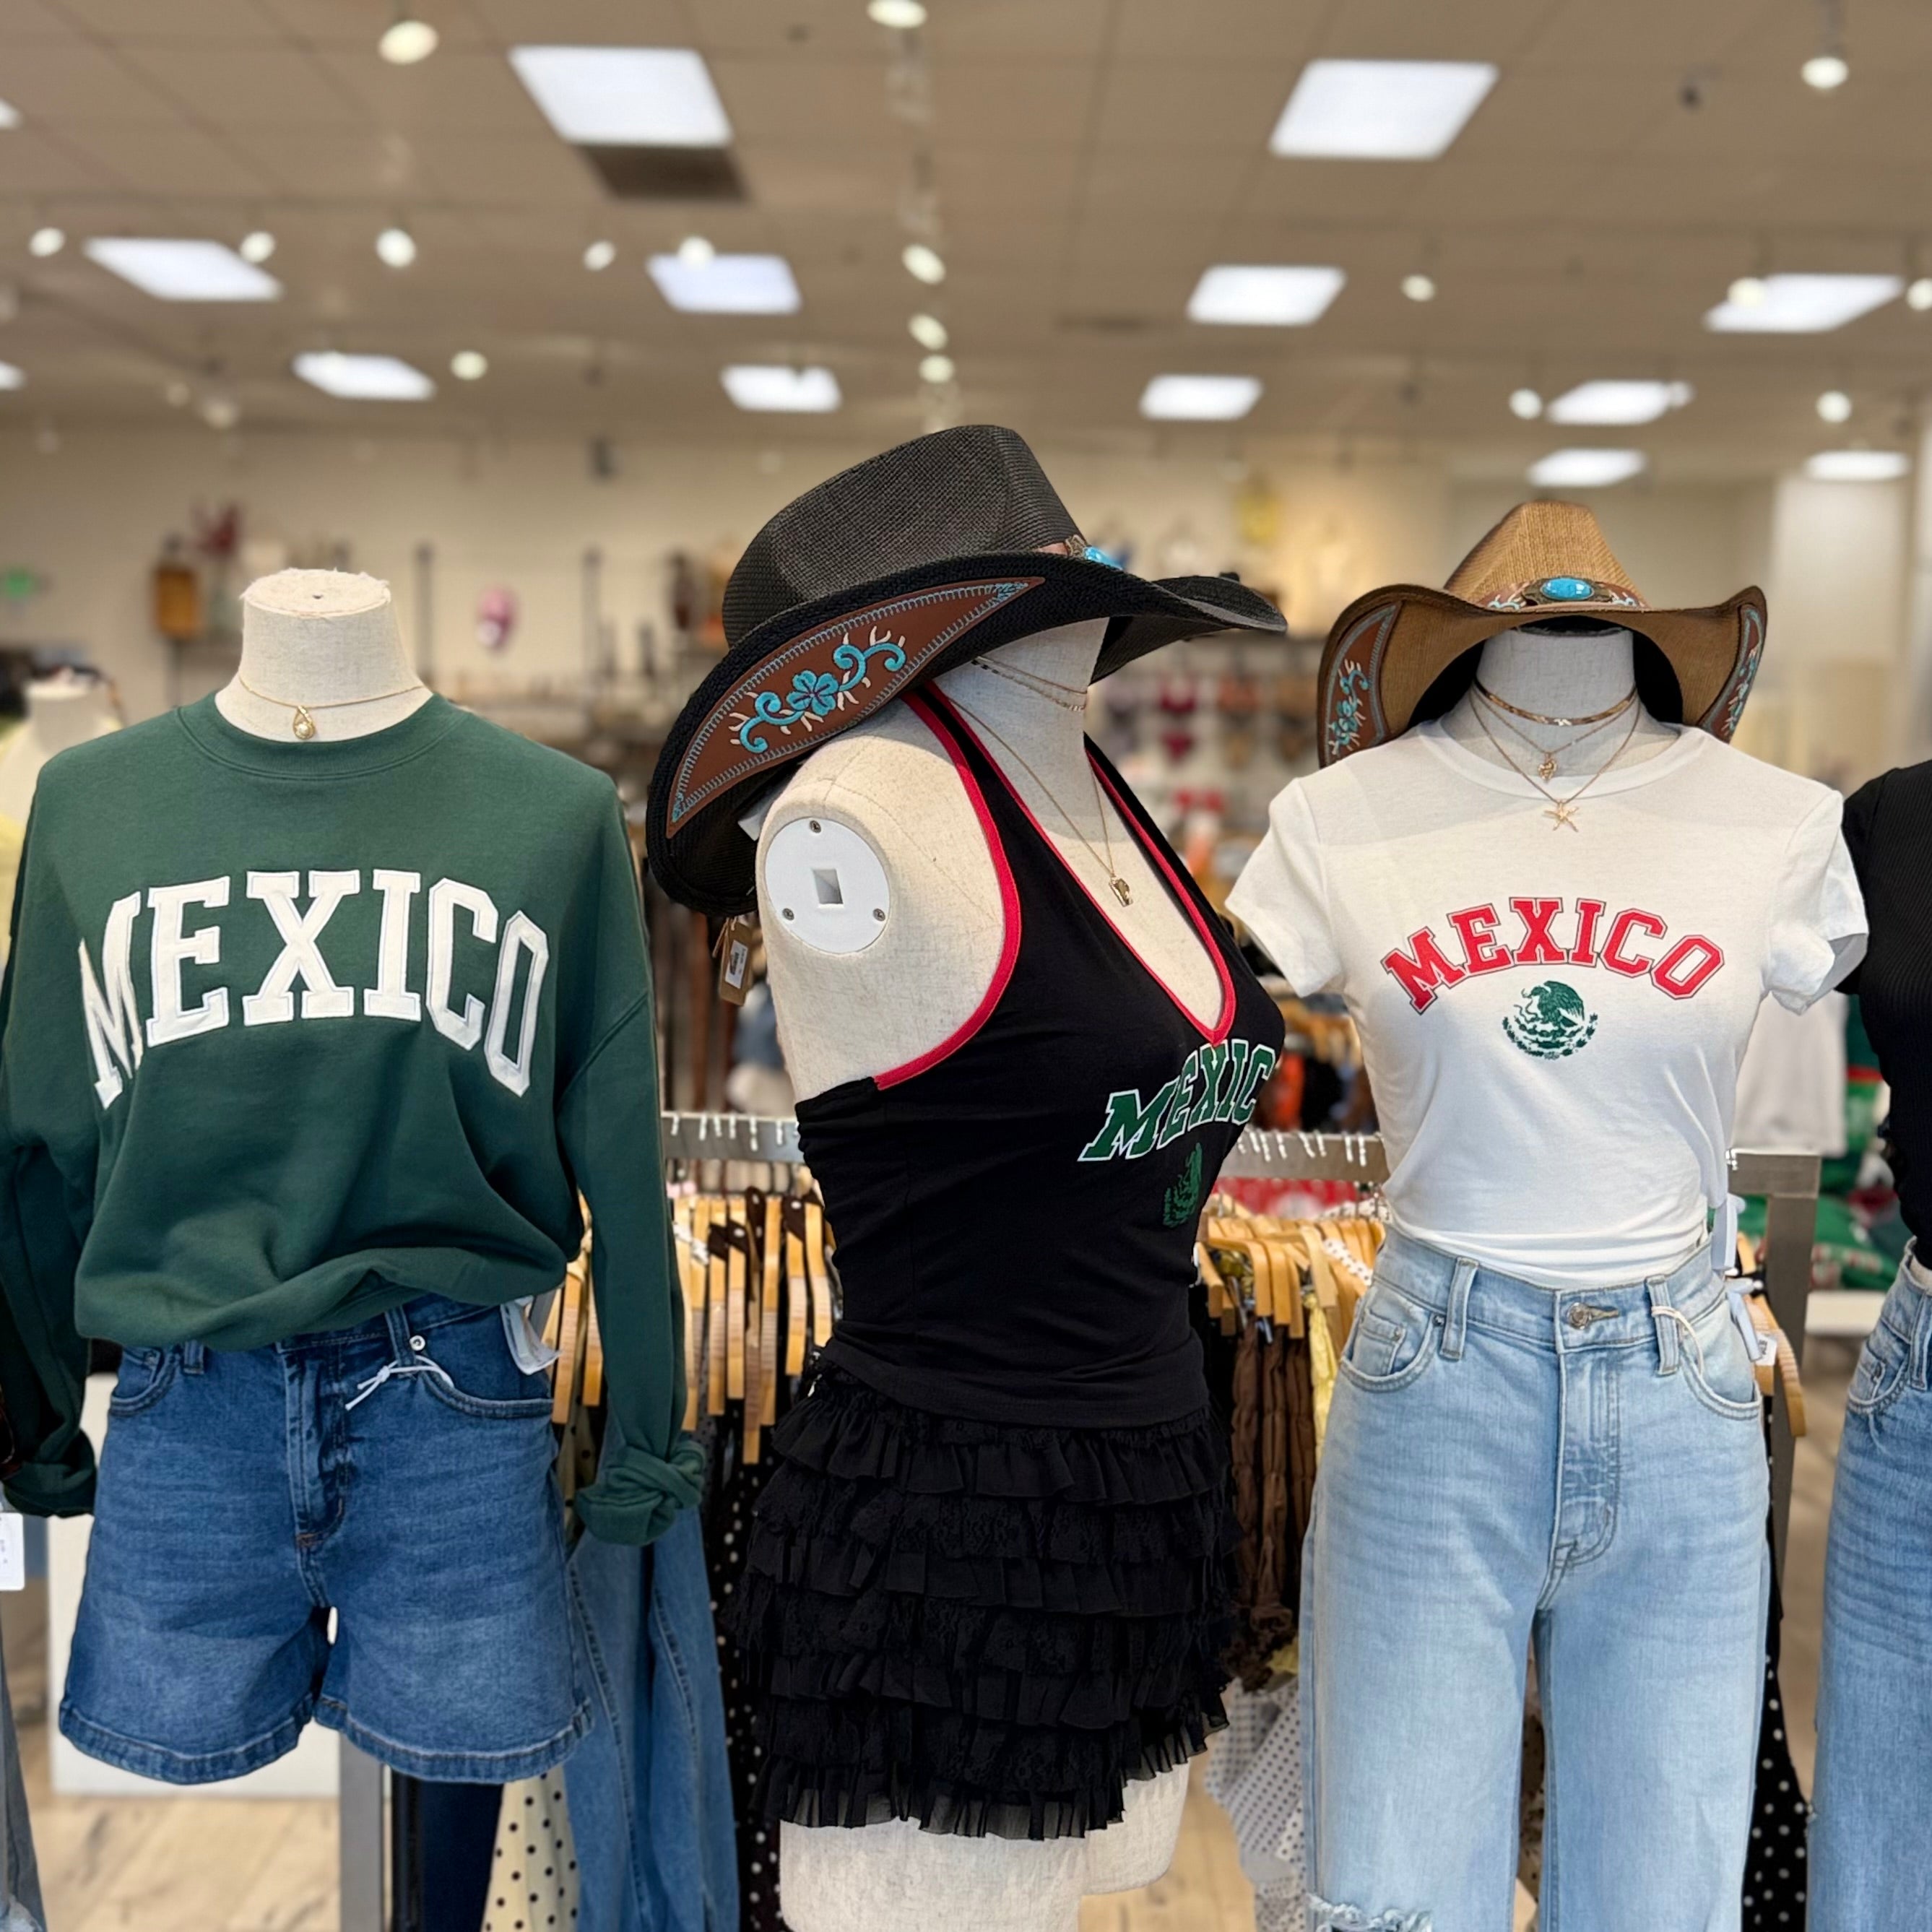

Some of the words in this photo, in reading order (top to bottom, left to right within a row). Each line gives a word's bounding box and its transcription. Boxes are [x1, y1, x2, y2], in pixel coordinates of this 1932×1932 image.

[78, 869, 549, 1110] MEXICO
[1379, 896, 1725, 1015] MEXICO
[1077, 1038, 1276, 1162] MEXIC
